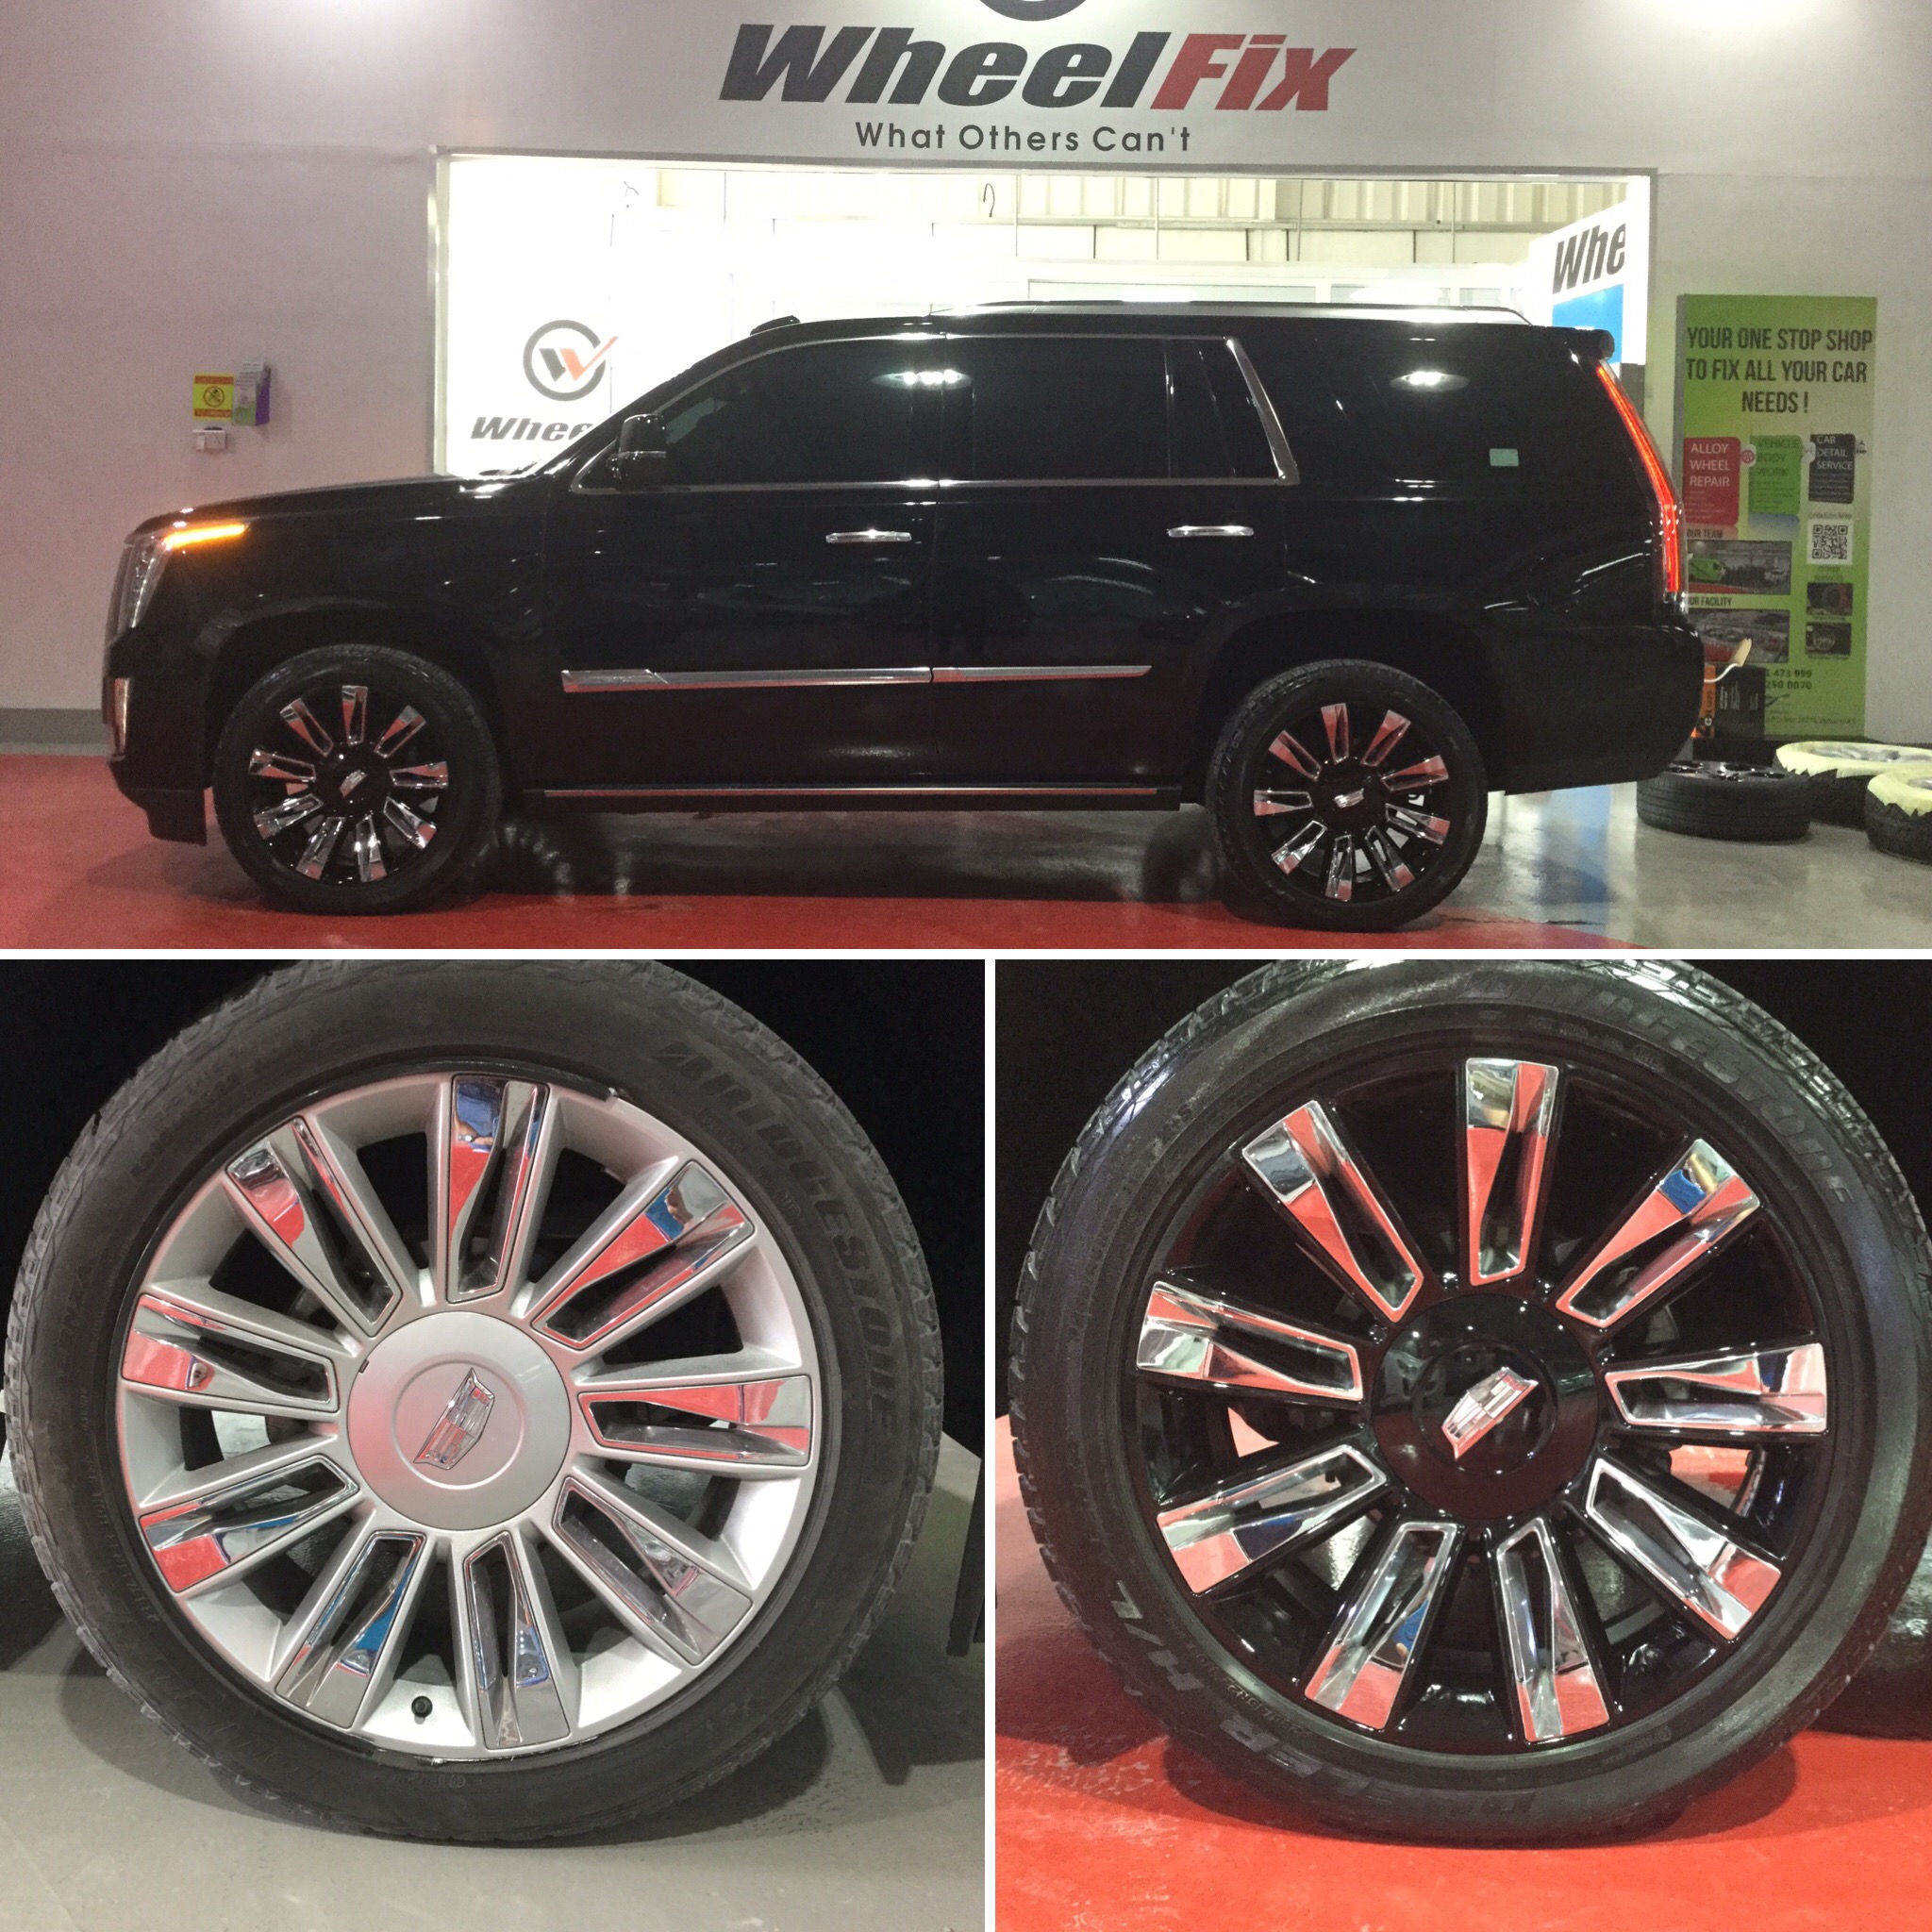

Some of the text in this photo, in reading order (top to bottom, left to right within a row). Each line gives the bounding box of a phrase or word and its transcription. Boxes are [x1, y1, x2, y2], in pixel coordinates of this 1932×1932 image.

[718, 24, 1357, 111] WheelFix
[855, 122, 1191, 153] What Others Can't
[1687, 326, 1874, 352] YOUR ONE STOP SHOP
[1686, 358, 1869, 383] TO FIX ALL YOUR CAR
[1741, 391, 1799, 413] NEEDS
[1757, 439, 1799, 449] VEHICLE
[1816, 435, 1837, 444] CAR
[1690, 442, 1730, 455] ALLOY
[1816, 447, 1848, 458] DETAIL
[1757, 453, 1786, 463] BODY
[1690, 459, 1731, 472] WHEEL
[1816, 460, 1854, 471] SERVICE
[1757, 467, 1790, 477] WORK
[1689, 475, 1731, 488] REPAIR
[1704, 529, 1724, 539] TEAM
[1701, 597, 1733, 607] FACILITY
[1774, 669, 1791, 678] 473
